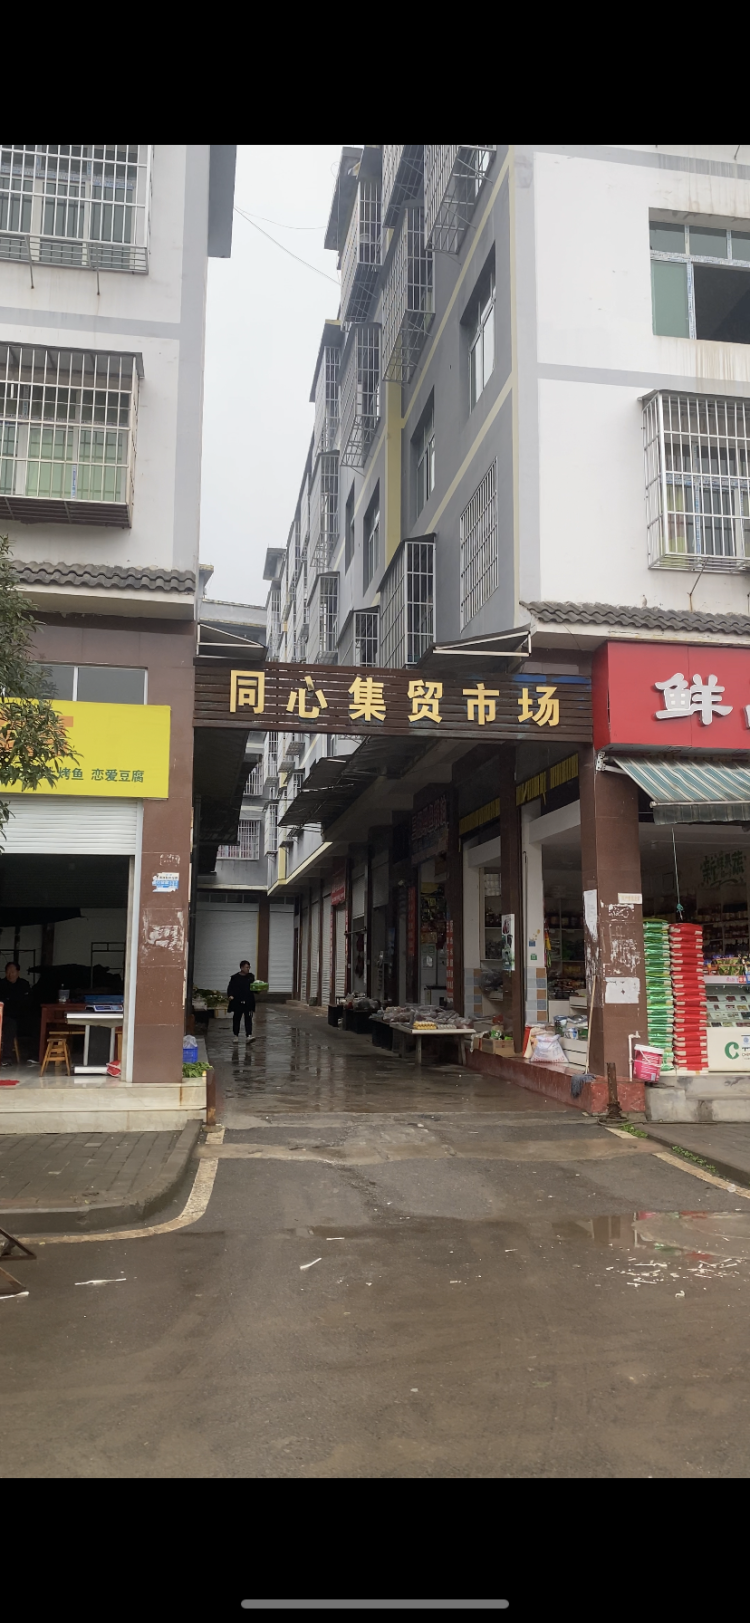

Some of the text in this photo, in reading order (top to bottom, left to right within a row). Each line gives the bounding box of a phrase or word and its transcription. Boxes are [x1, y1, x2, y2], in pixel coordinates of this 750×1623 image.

[230, 669, 560, 727] 同心集贸市场
[655, 672, 750, 729] 鲜
[91, 768, 144, 783] 恋爱豆腐
